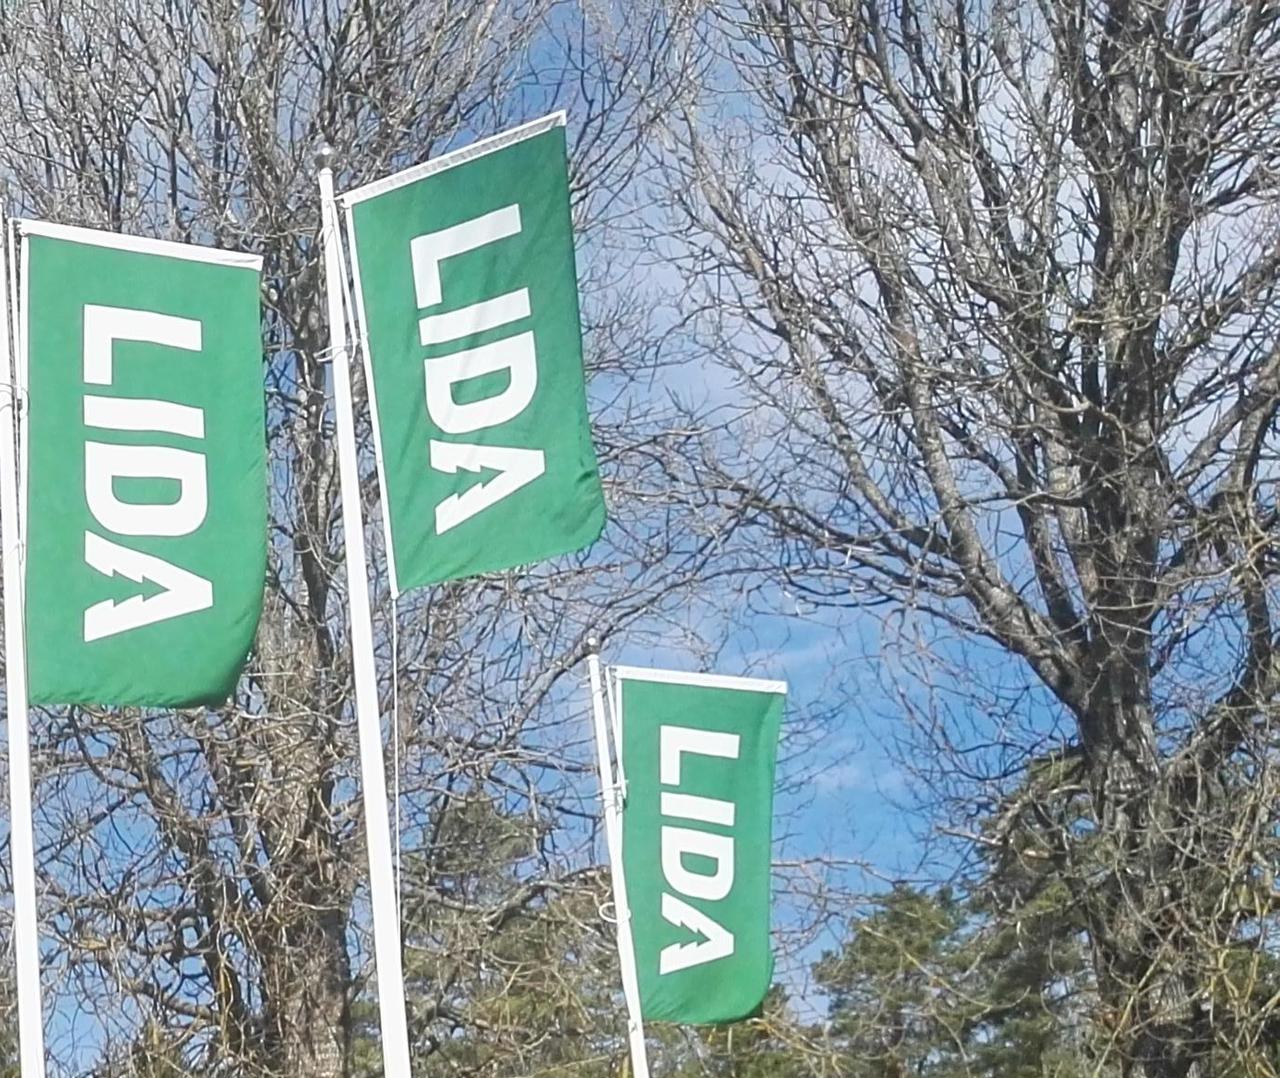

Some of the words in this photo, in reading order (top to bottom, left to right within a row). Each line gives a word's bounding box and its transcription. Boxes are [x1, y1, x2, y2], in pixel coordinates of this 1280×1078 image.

[83, 304, 214, 642] LIDA
[411, 204, 546, 535] LIDA
[660, 724, 741, 975] LIDA
